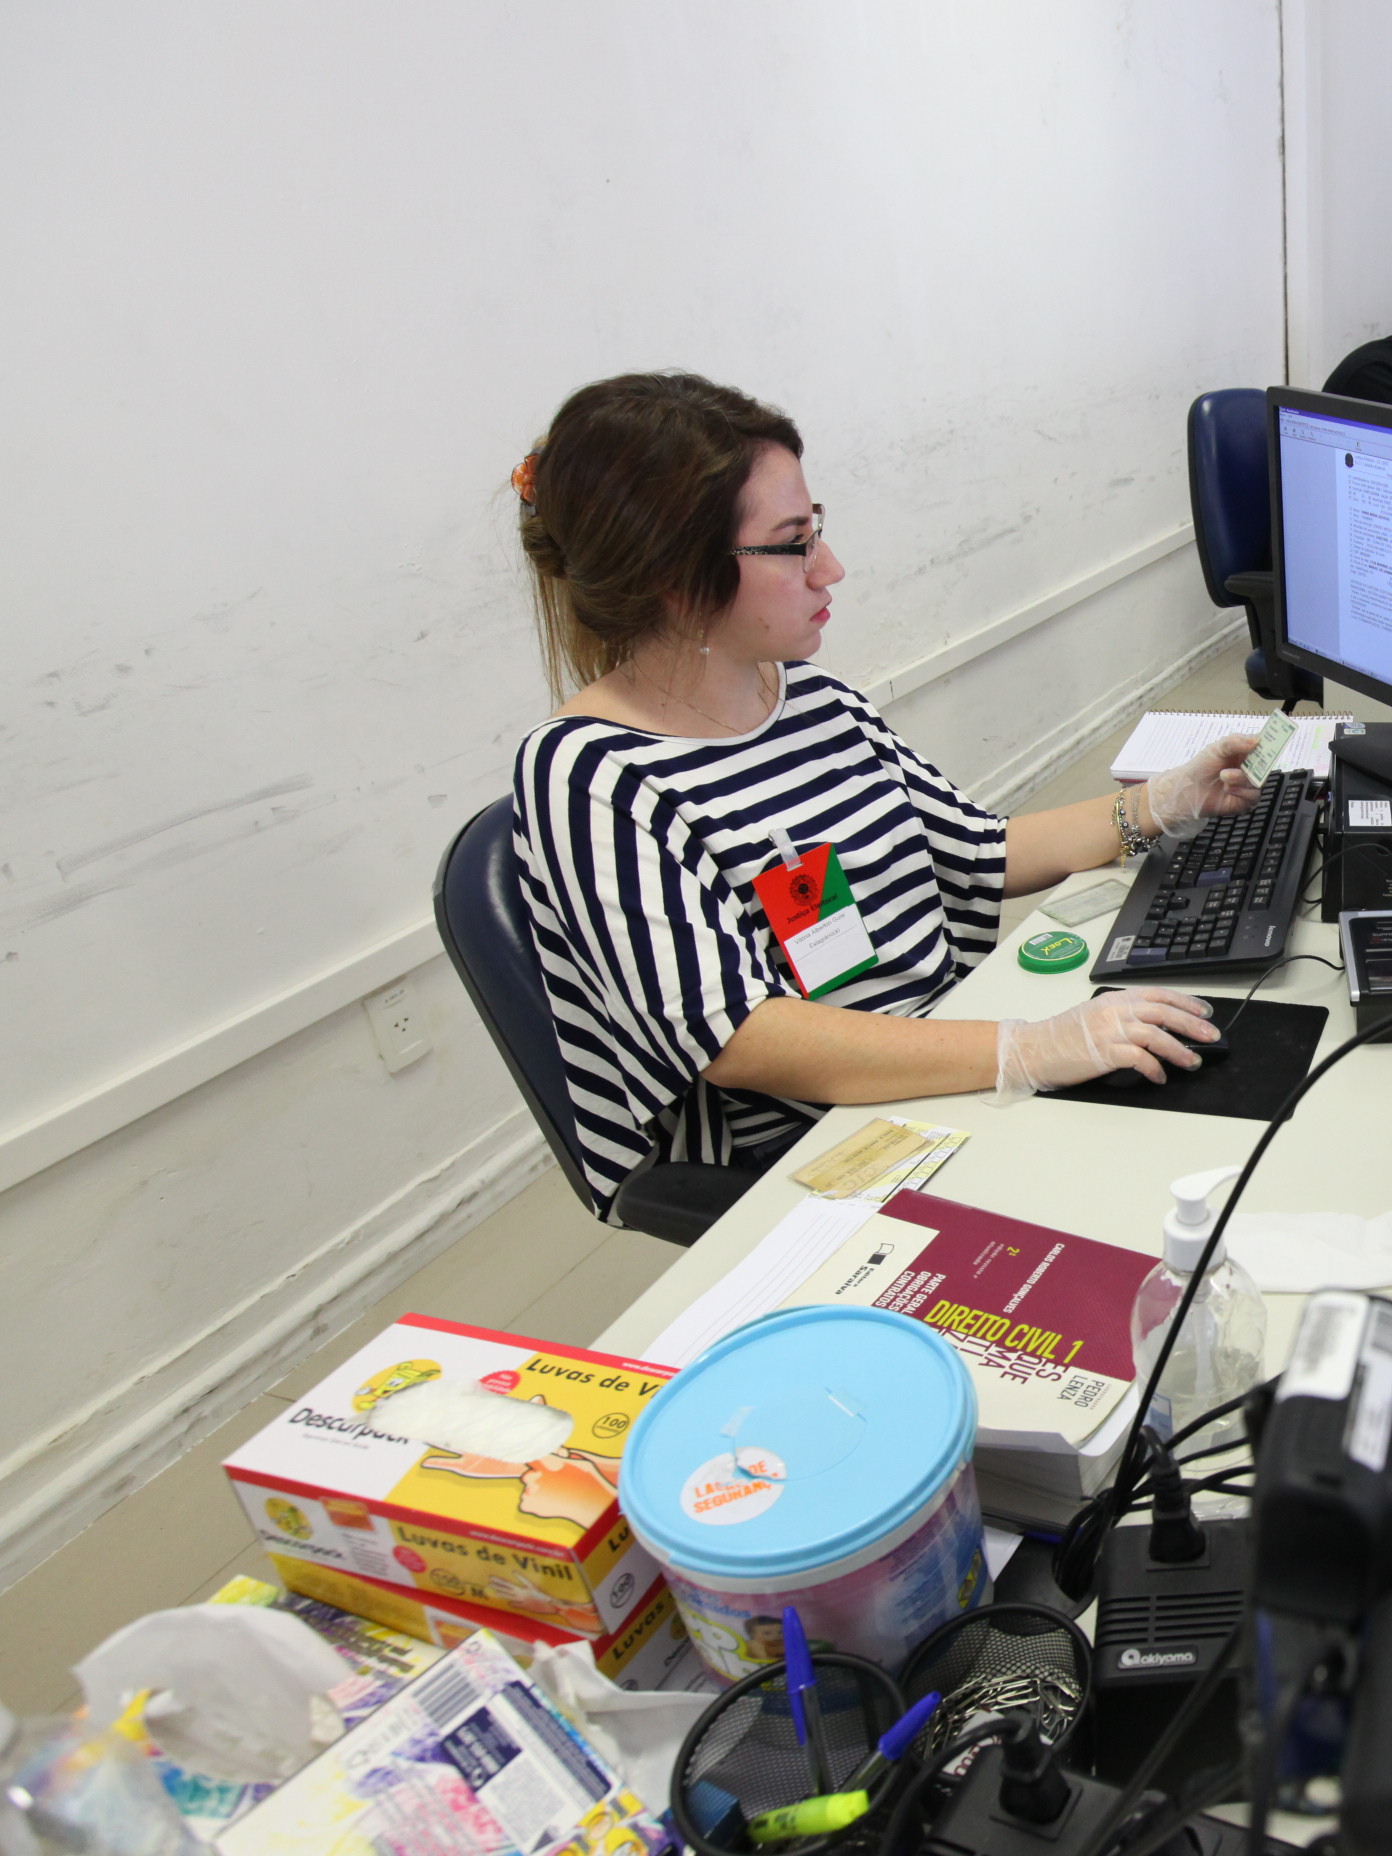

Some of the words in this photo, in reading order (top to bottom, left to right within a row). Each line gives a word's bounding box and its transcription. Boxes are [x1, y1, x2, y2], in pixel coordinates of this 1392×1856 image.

[786, 909, 810, 924] Justiça
[810, 893, 838, 911] Eleitoral
[1264, 925, 1276, 947] lenovo
[1044, 1243, 1065, 1263] CARLOS
[835, 1265, 868, 1295] Saraiva
[920, 1273, 947, 1295] PARTE
[1026, 1261, 1050, 1285] ROBERTO
[874, 1270, 916, 1308] CONTRATOS
[888, 1270, 932, 1312] OBRIGAÇÕES
[901, 1293, 928, 1314] GERAL
[1003, 1283, 1033, 1314] GONÇALVES
[923, 1299, 1011, 1342] DIREITO
[1004, 1323, 1063, 1359] CIVIL
[1063, 1340, 1084, 1364] 1
[526, 1358, 595, 1384] Luvas
[598, 1375, 630, 1392] de
[1056, 1374, 1088, 1401] LENZA
[1074, 1379, 1105, 1408] PEDRO
[602, 1416, 628, 1429] 100
[396, 1526, 469, 1556] Luvas
[475, 1546, 506, 1566] de
[512, 1553, 573, 1581] Vinil
[613, 1602, 665, 1660] Luvas
